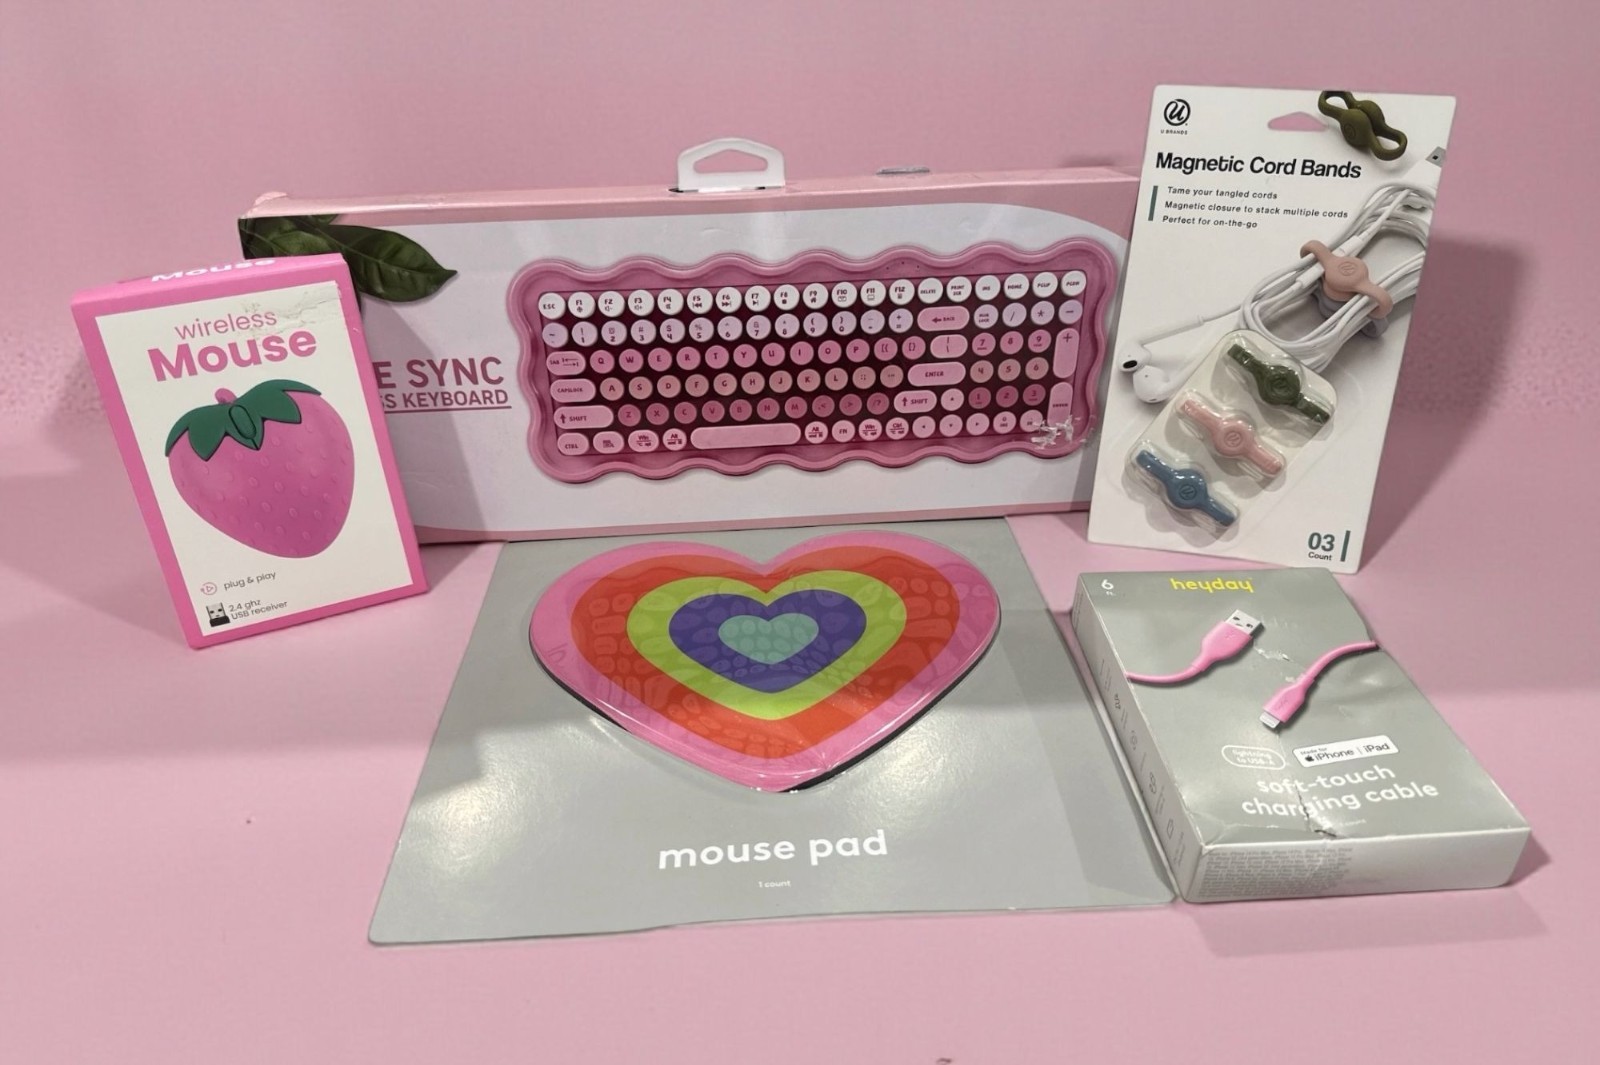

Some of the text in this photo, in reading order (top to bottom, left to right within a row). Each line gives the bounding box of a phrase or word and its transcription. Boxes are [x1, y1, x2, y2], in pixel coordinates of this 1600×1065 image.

[1156, 152, 1362, 179] Magnetic Cord Bands
[1167, 186, 1278, 200] Tame your tangled cords
[1164, 201, 1348, 218] Magnetic closure to stack multiple cords
[1162, 215, 1258, 229] Perfect for on-the-go
[151, 259, 276, 282] Mouse
[174, 310, 278, 340] wireless
[147, 330, 317, 382] Mouse
[406, 356, 504, 388] SYNC
[403, 389, 508, 408] KEYBOARD
[1308, 532, 1336, 552] 03
[1308, 551, 1332, 561] Count
[224, 579, 245, 591] plug
[256, 572, 276, 584] play
[1101, 579, 1114, 590] 6
[1170, 578, 1254, 593] heyday
[229, 599, 261, 612] 2.4 ghz
[231, 601, 288, 620] USB receiver
[1314, 742, 1390, 761] iPhone iPad
[1257, 765, 1396, 794] soft-touch
[1241, 782, 1439, 819] charging cable
[658, 829, 888, 870] mouse pad
[758, 879, 791, 888] 1 count
